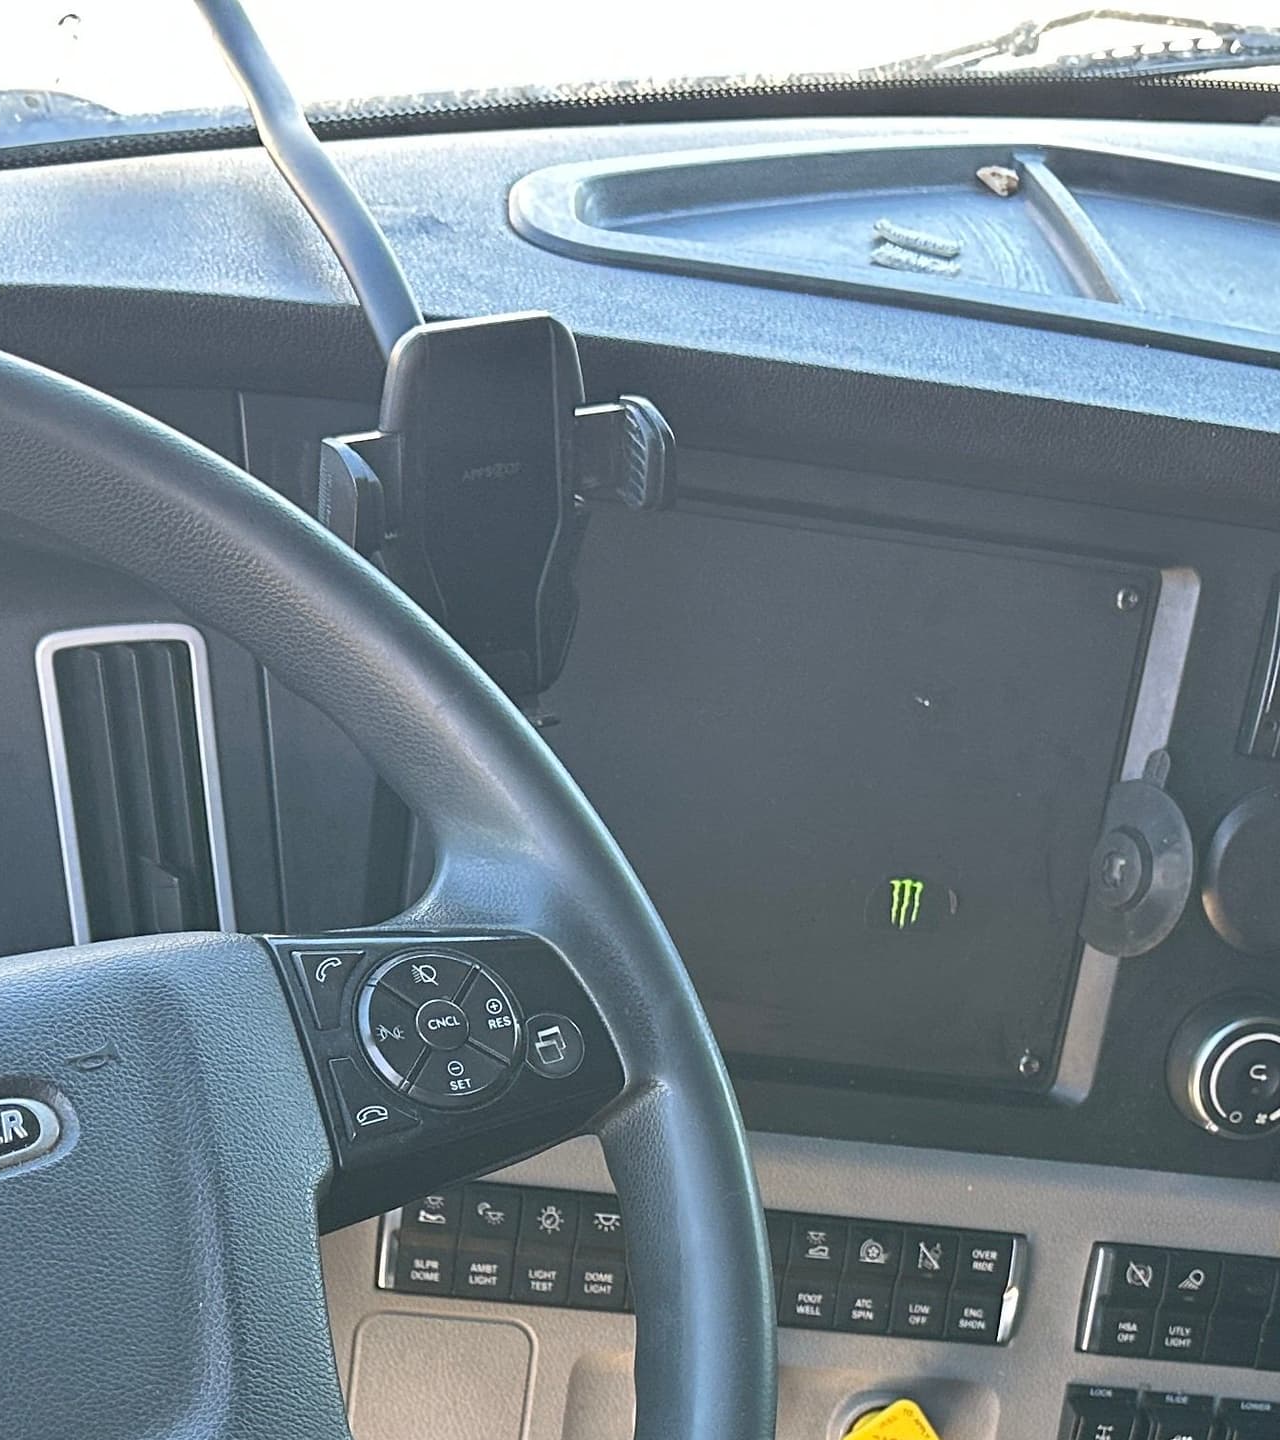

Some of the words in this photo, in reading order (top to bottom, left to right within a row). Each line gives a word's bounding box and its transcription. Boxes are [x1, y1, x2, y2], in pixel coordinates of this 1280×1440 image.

[427, 1015, 461, 1031] CNCL
[488, 1016, 512, 1030] RES
[449, 1078, 472, 1091] SET
[972, 1249, 998, 1261] OVER
[470, 1263, 498, 1274] AMBT
[972, 1261, 995, 1272] RIDE
[410, 1271, 441, 1282] DOME
[468, 1274, 498, 1286] LIGHT
[528, 1269, 557, 1281] LIGHT
[584, 1272, 614, 1283] DOME
[530, 1281, 553, 1292] TEST
[584, 1283, 612, 1295] LIGHT
[798, 1292, 823, 1304] FOOT
[855, 1298, 873, 1309] ATC
[796, 1305, 822, 1316] WELL
[851, 1310, 874, 1321] SPIN
[963, 1307, 985, 1319] ENG
[908, 1315, 928, 1326] OFF
[1168, 1325, 1193, 1337] UTLY
[1116, 1332, 1136, 1343] OFF
[1164, 1336, 1192, 1348] LIGHT
